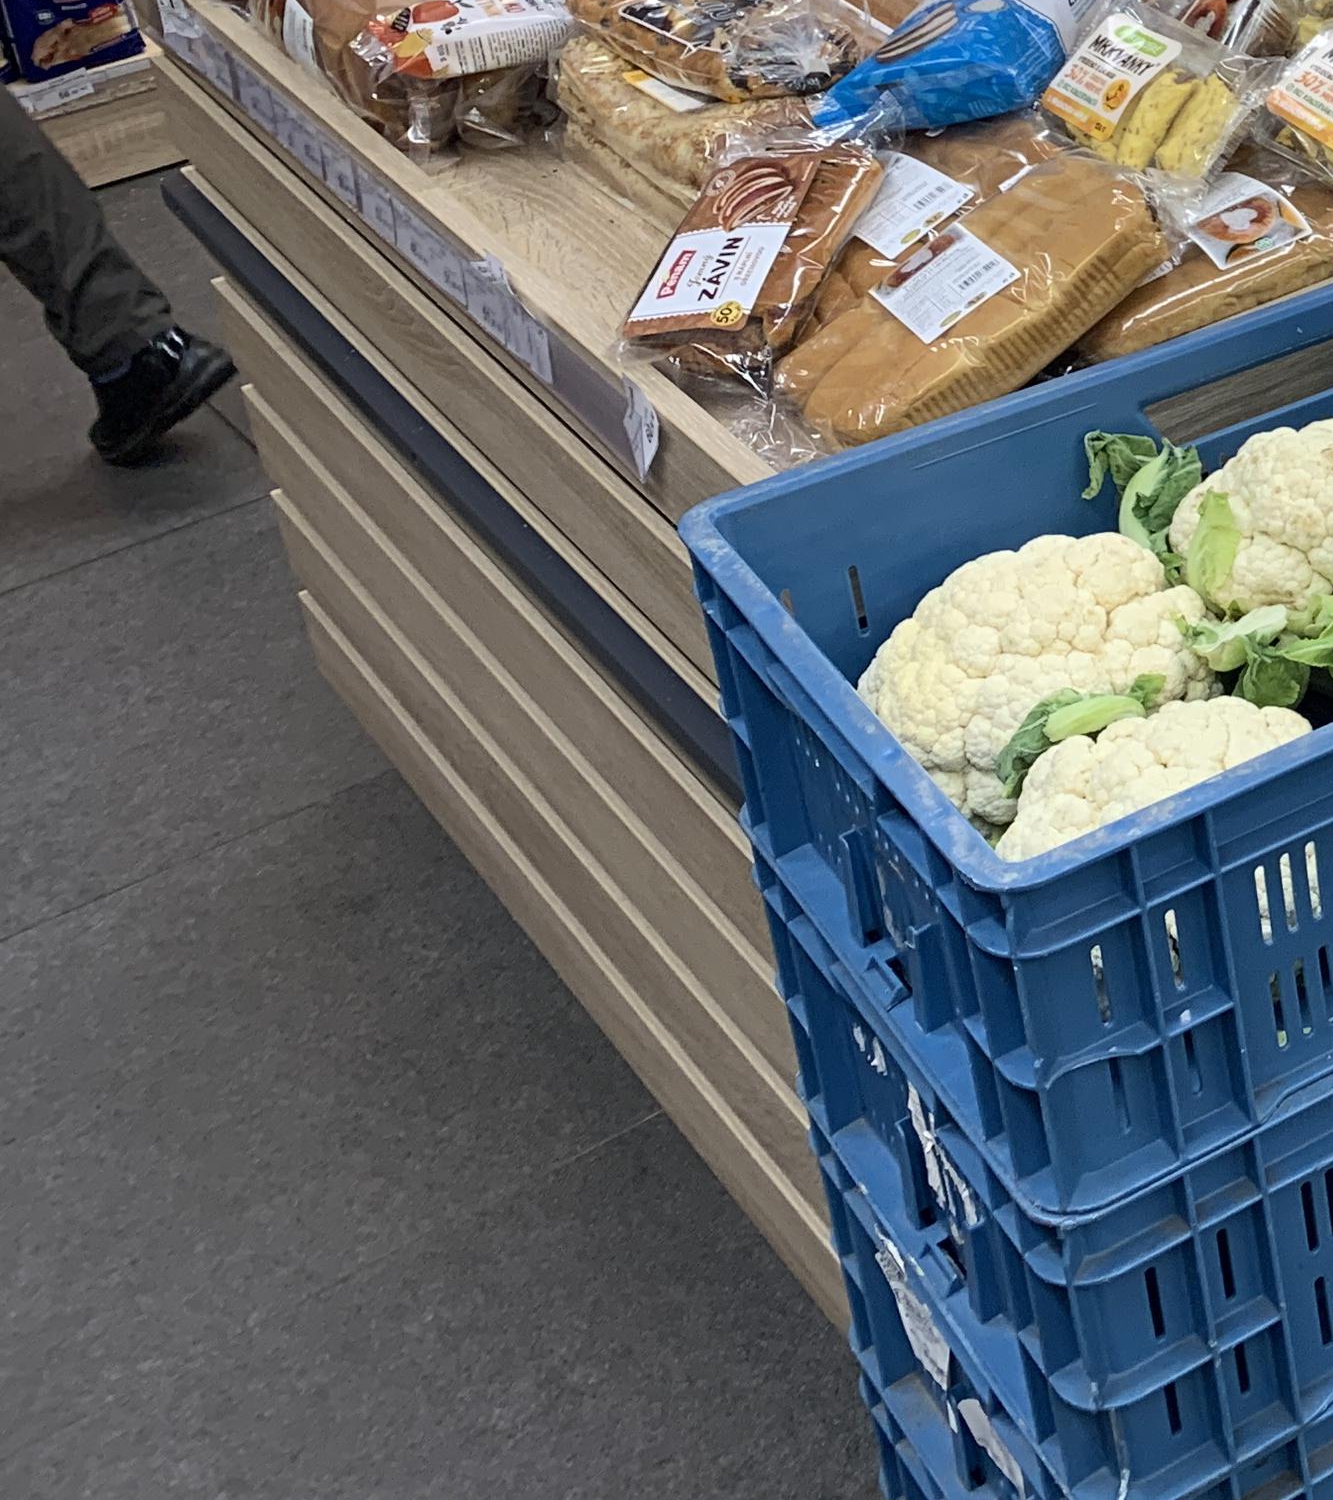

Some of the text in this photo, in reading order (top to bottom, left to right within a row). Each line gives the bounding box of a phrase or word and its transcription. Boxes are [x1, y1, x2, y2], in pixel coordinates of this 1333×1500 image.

[657, 250, 696, 298] Penam
[698, 236, 744, 302] ZÁVIN
[717, 307, 732, 324] 50
